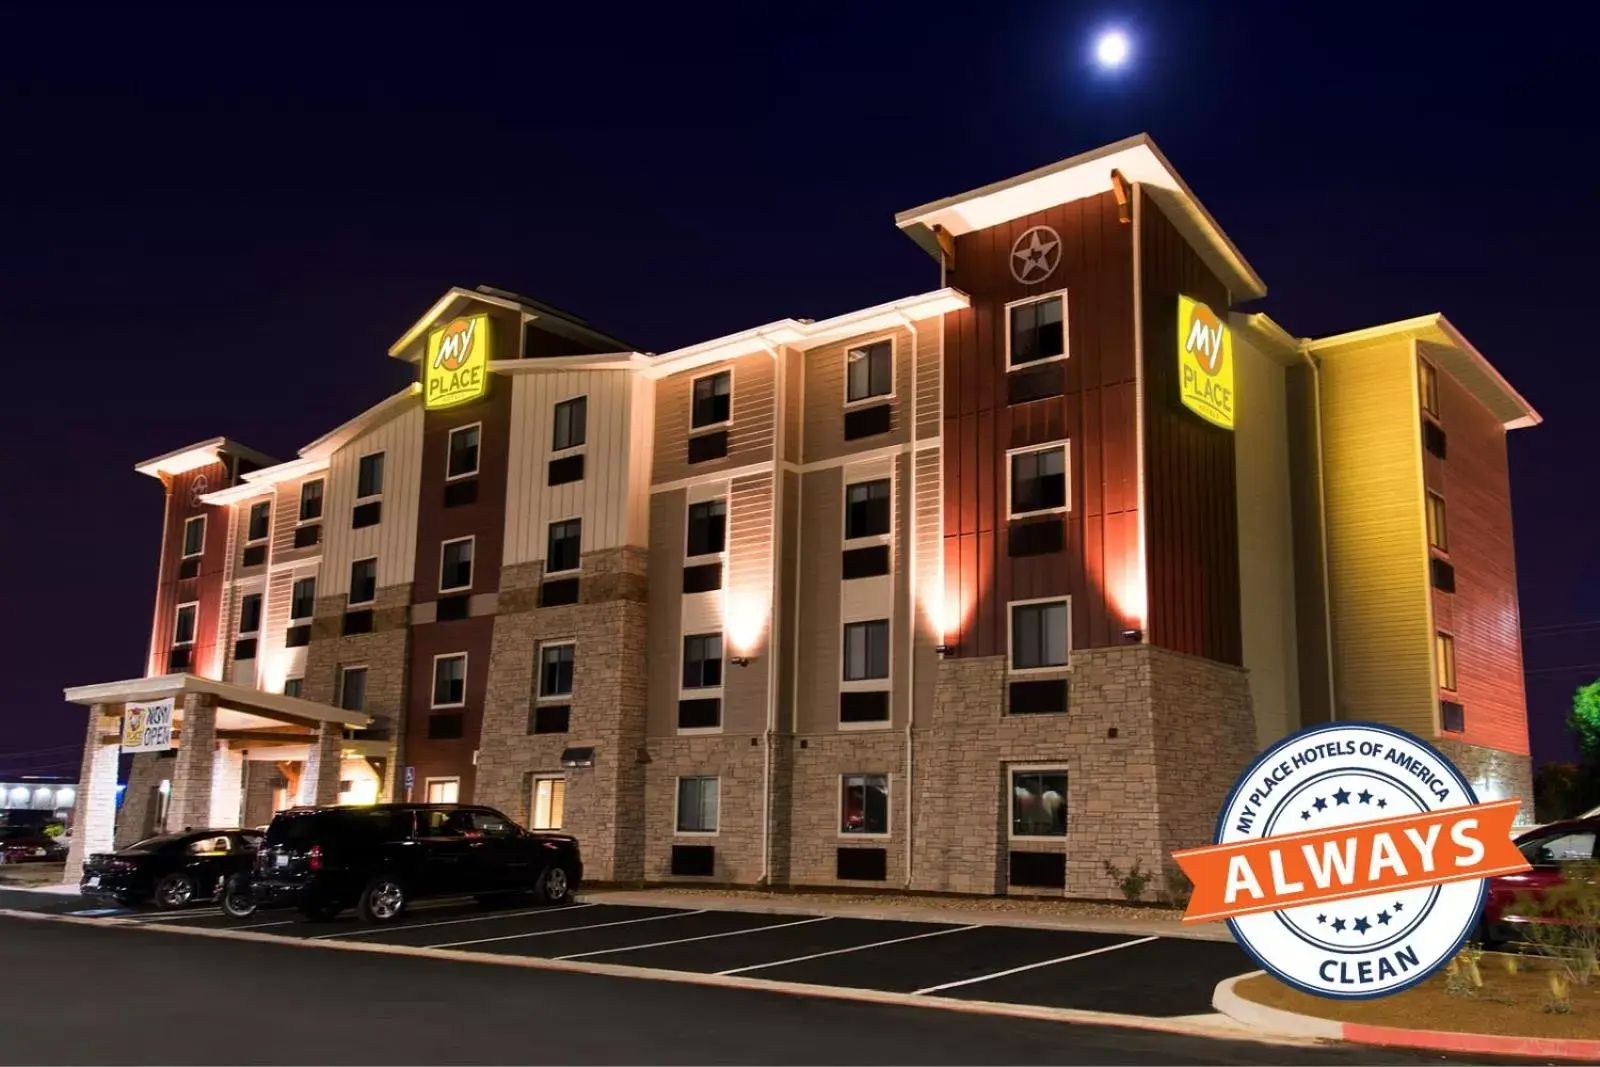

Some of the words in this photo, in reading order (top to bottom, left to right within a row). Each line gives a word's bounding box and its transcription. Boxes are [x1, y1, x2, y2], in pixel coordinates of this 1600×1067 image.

[429, 365, 482, 396] PLACE
[1183, 364, 1232, 412] PLACE
[144, 725, 169, 746] OPEN
